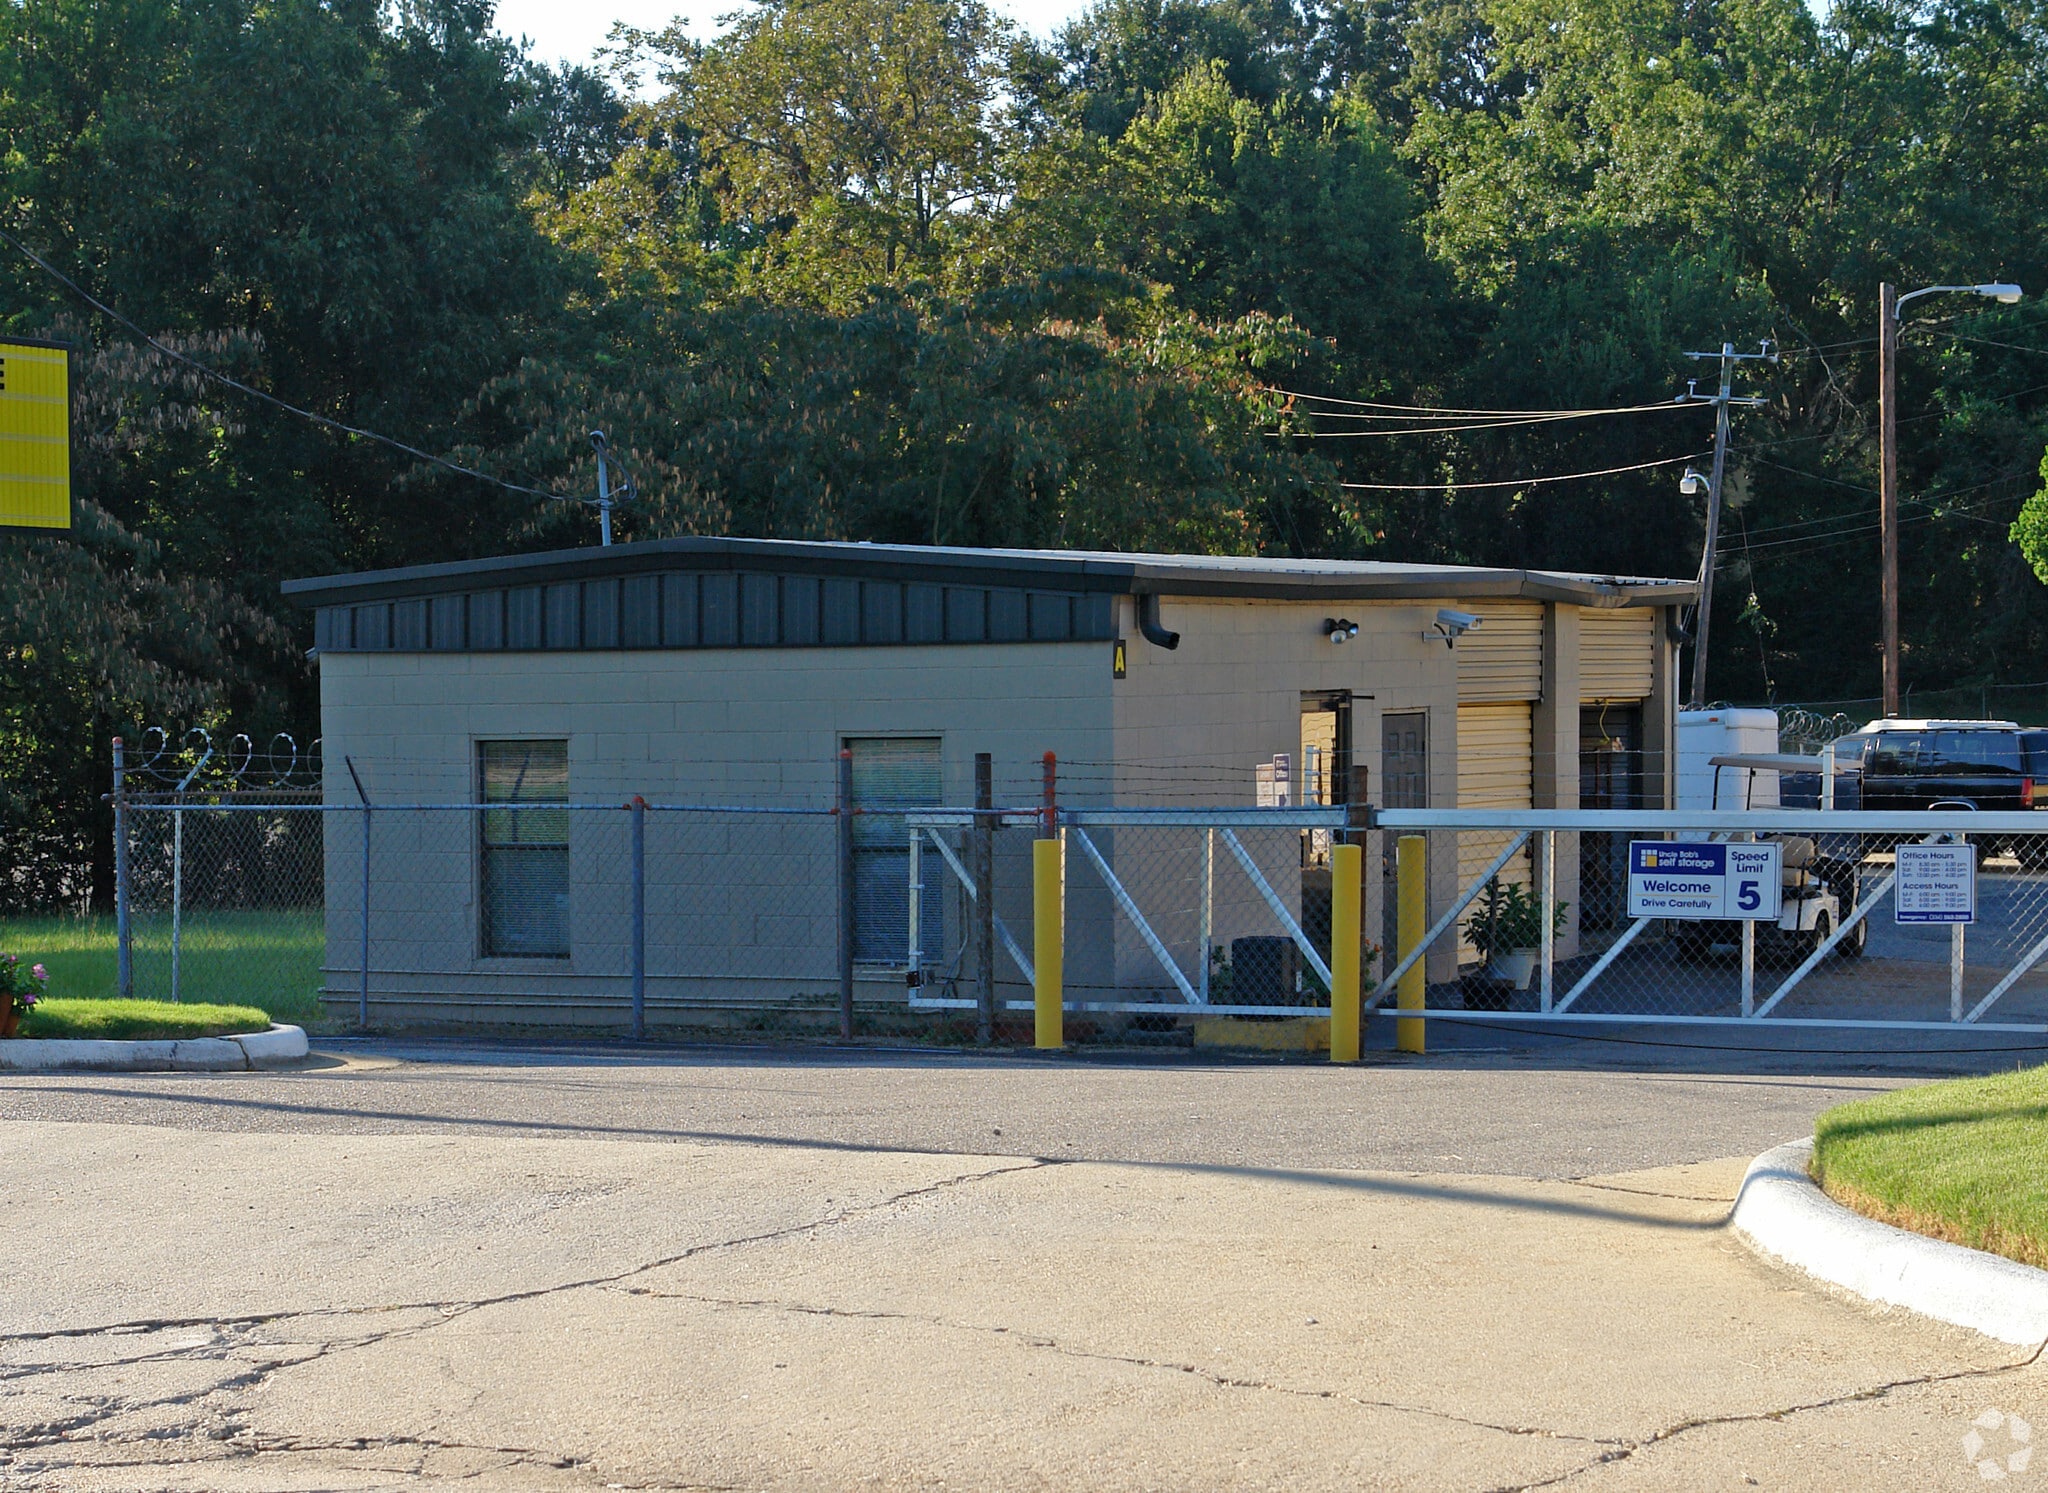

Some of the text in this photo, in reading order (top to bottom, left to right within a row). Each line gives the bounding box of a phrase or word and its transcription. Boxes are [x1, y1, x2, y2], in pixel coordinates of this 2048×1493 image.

[1115, 646, 1125, 671] A
[1731, 851, 1769, 863] Speed
[1658, 858, 1715, 870] self storage
[1736, 863, 1763, 873] Limit
[1643, 880, 1711, 893] Welcome
[1737, 880, 1761, 911] 5
[1641, 899, 1712, 909] Drive Carefully
